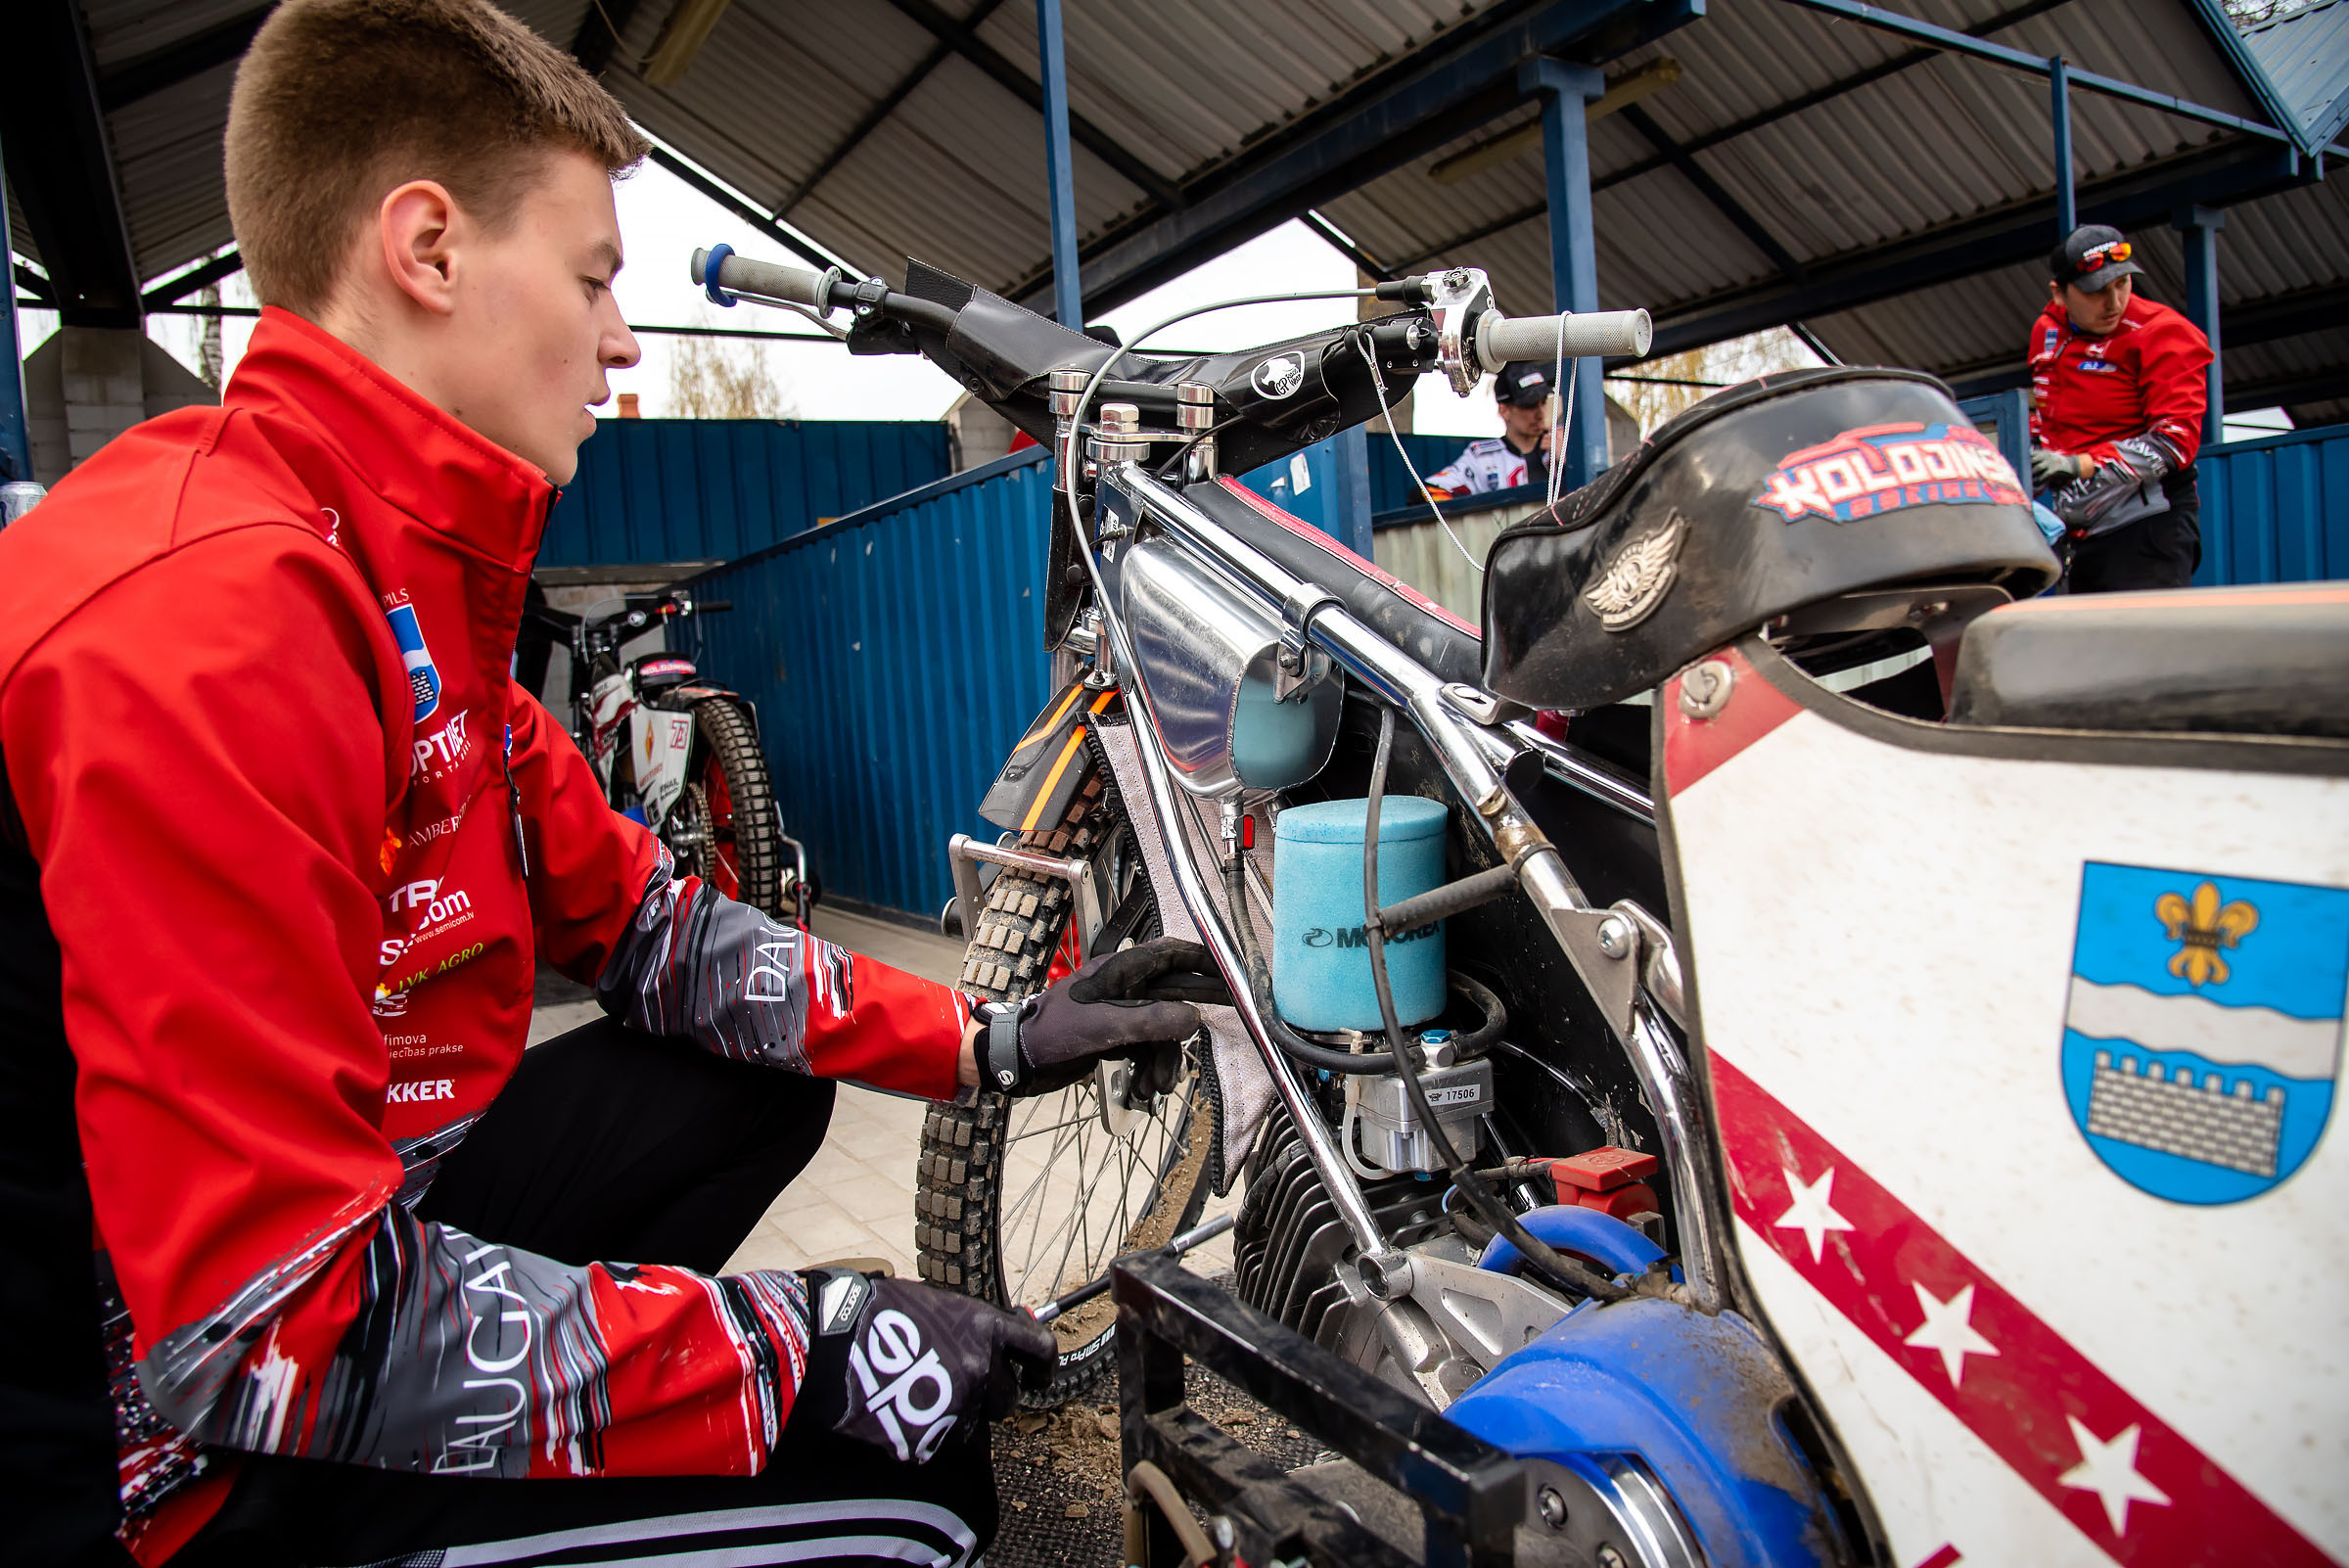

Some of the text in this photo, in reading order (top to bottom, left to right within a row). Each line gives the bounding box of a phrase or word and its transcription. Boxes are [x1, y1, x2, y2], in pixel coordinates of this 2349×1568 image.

[1275, 377, 1289, 395] GP
[383, 587, 409, 608] PILS
[415, 911, 475, 945] www.semicom.lv
[1336, 921, 1440, 948] MOREX
[438, 942, 484, 975] AGRO
[384, 1034, 427, 1046] fimova
[428, 1043, 464, 1057] prakse
[1446, 1088, 1475, 1101] 17506
